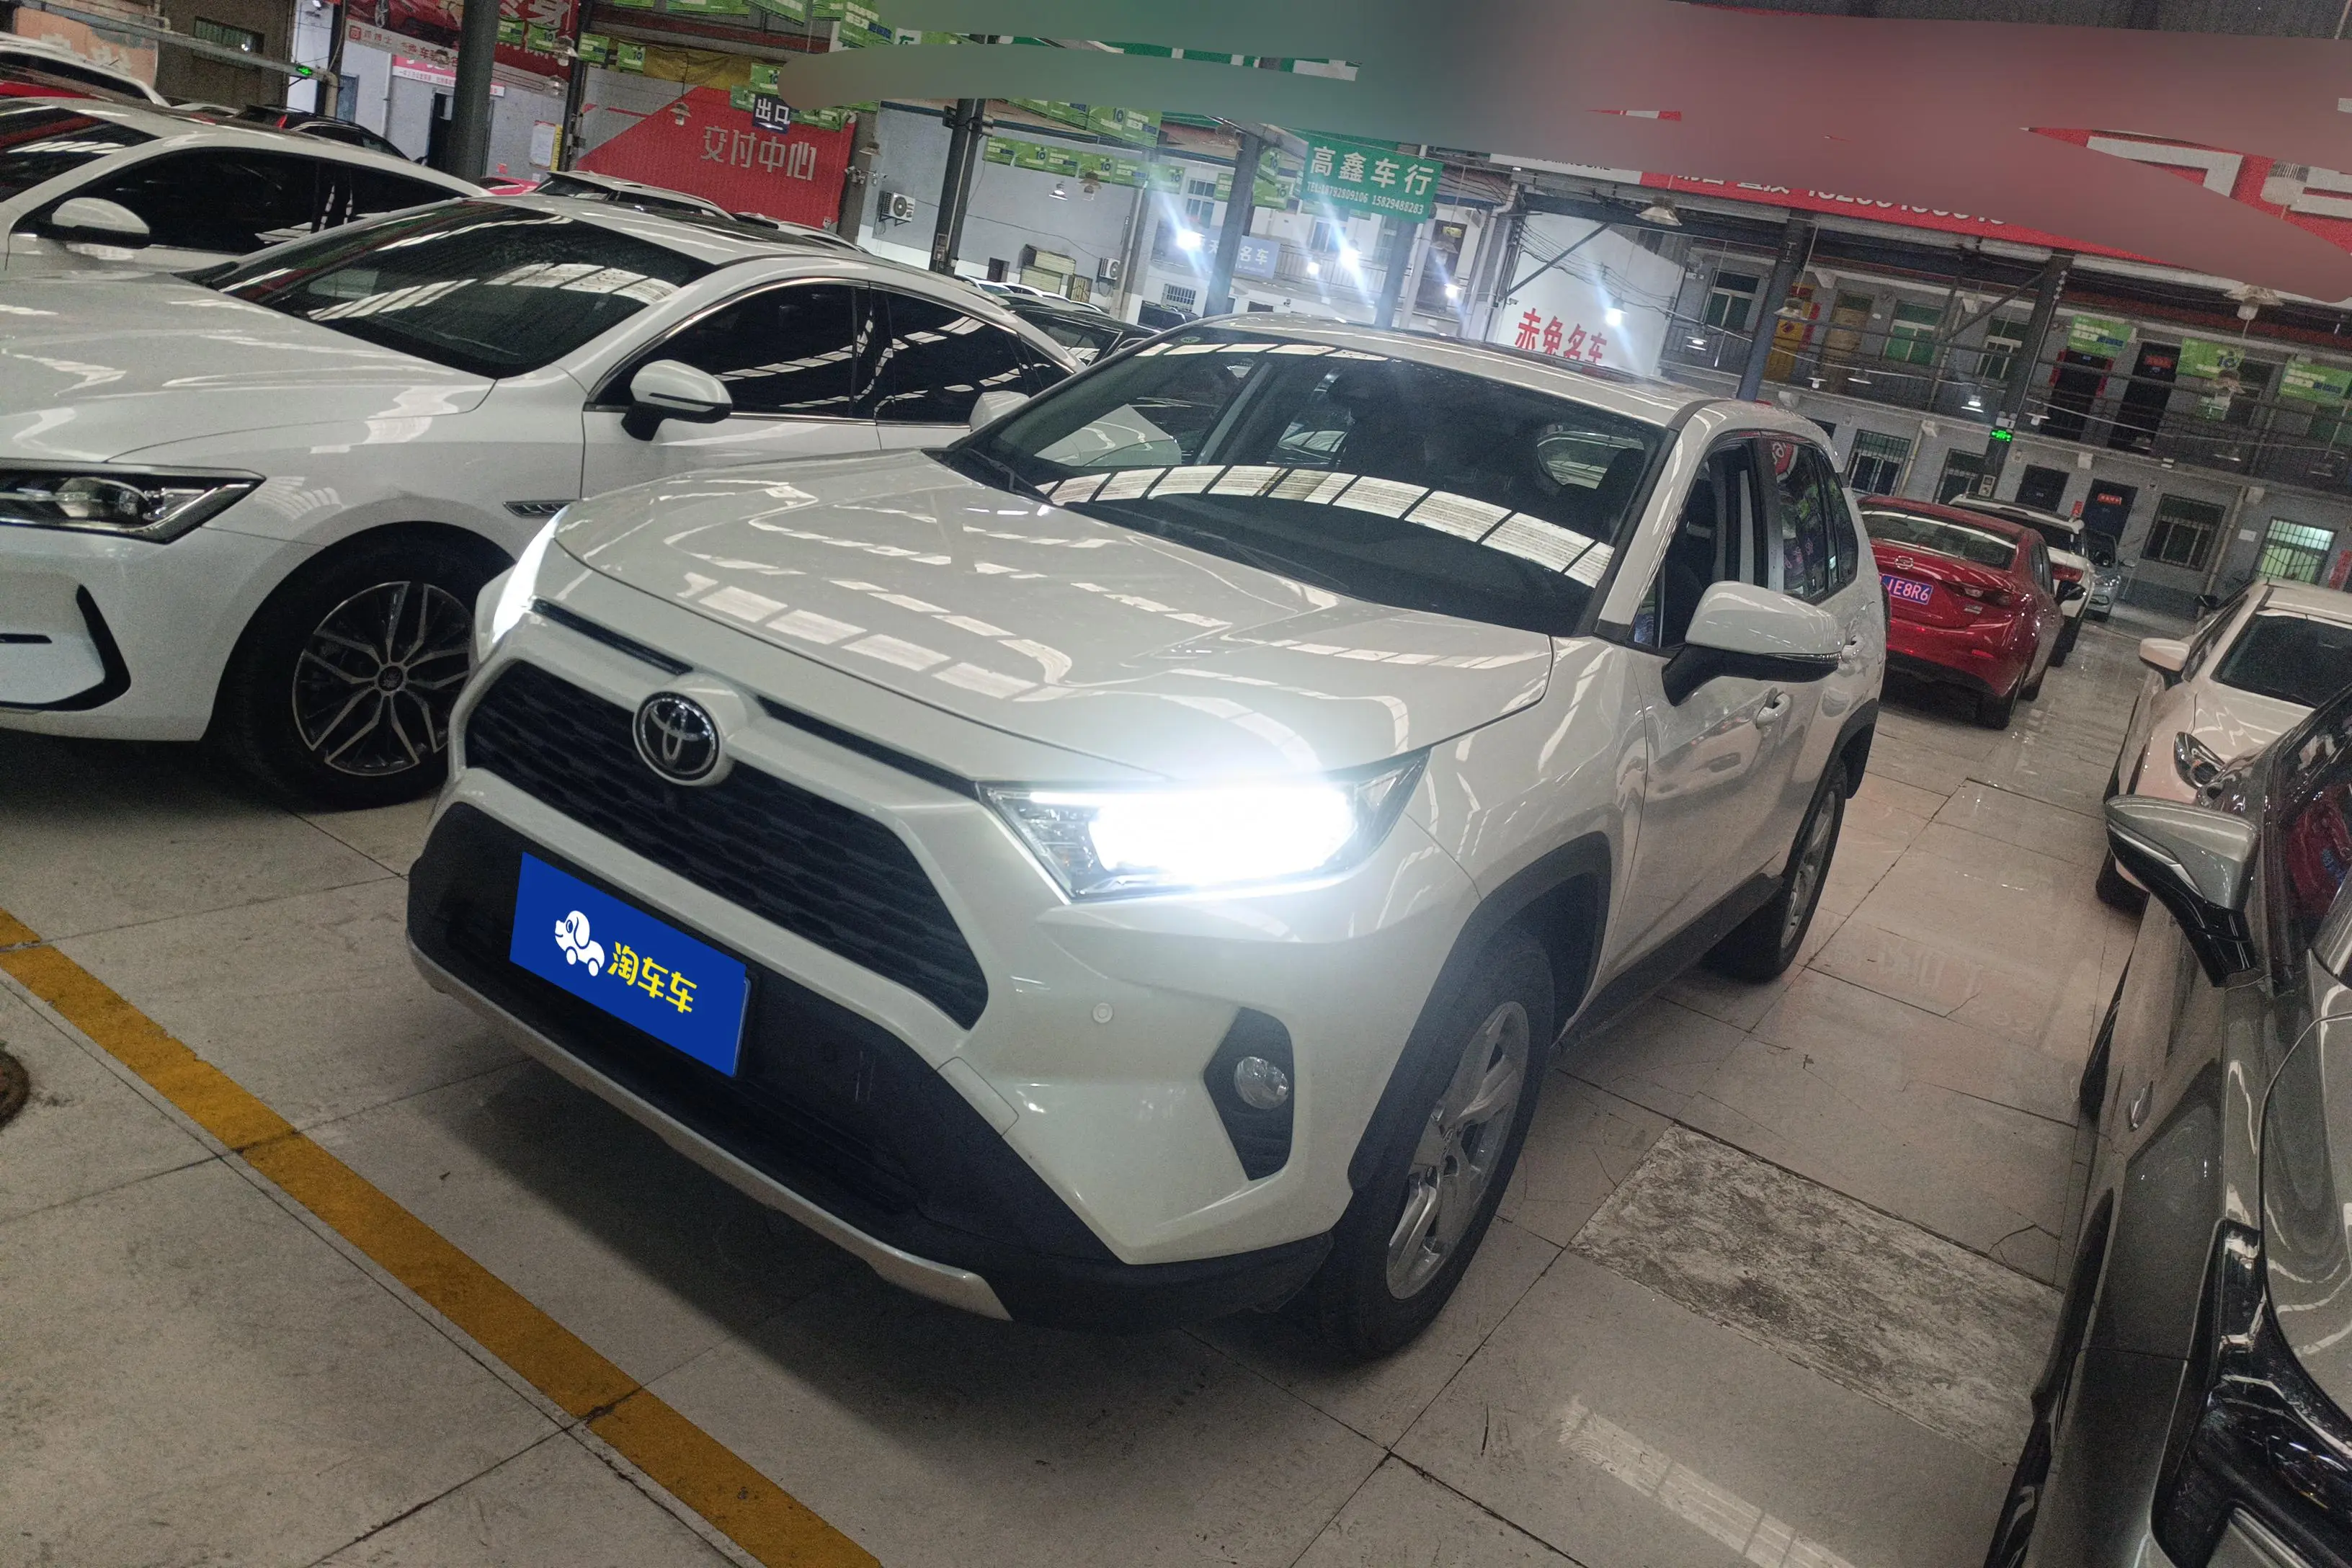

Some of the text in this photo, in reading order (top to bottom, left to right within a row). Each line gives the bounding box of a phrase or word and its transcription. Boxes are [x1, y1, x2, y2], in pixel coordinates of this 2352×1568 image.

[756, 97, 790, 124] 出口
[700, 125, 817, 181] 交付中心
[1310, 146, 1434, 196] 高鑫车行
